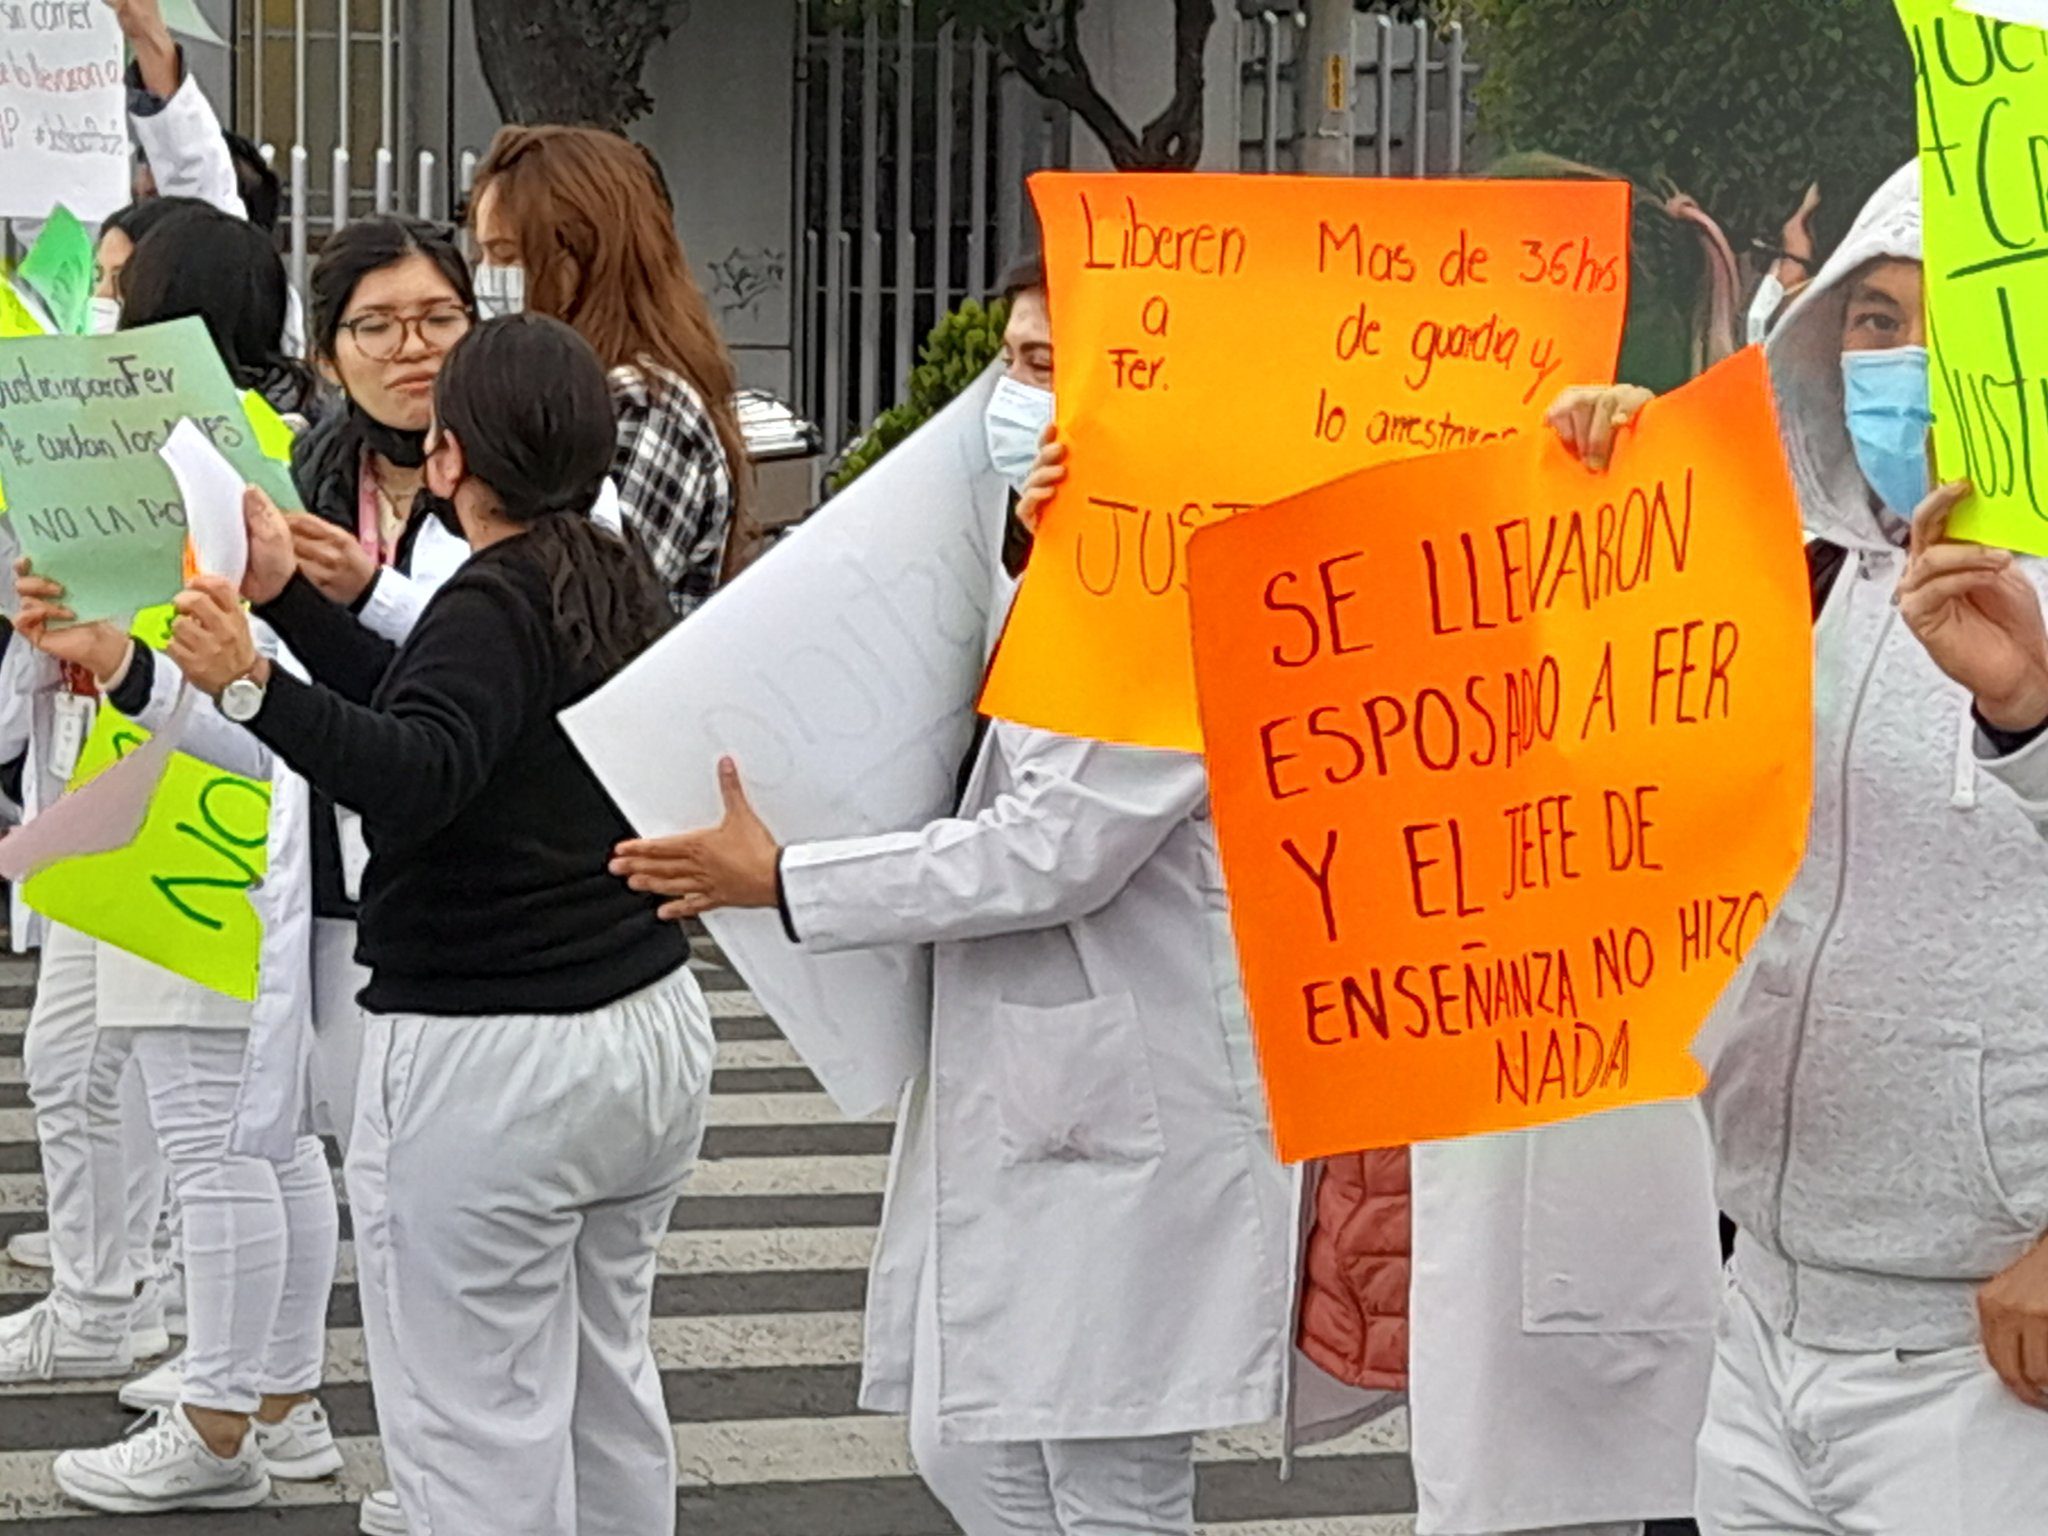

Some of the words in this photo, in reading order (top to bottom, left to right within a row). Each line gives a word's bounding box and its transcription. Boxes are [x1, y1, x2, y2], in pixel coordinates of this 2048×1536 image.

[1080, 192, 1247, 276] Liberen
[1317, 220, 1416, 283] Mas
[1438, 229, 1489, 287] de
[1335, 302, 1381, 363] de
[1404, 312, 1521, 391] guardia
[1521, 337, 1563, 406] y
[1314, 388, 1347, 443] lo
[28, 507, 80, 543] NO
[86, 505, 136, 536] LA
[1263, 550, 1375, 668] SE
[1420, 467, 1694, 636] LLEVARON
[1260, 655, 1561, 800] ESPOSADO
[1581, 641, 1616, 740] A
[1650, 620, 1740, 725] FER
[1281, 829, 1338, 942] Y
[1402, 818, 1485, 919] EL
[1503, 795, 1581, 900] JEFE
[1604, 786, 1664, 872] DE
[1302, 941, 1578, 1046] ENSEÑANZA
[1593, 927, 1655, 1000] NO
[1679, 890, 1770, 973] HIZO
[1495, 1019, 1630, 1107] NADA
